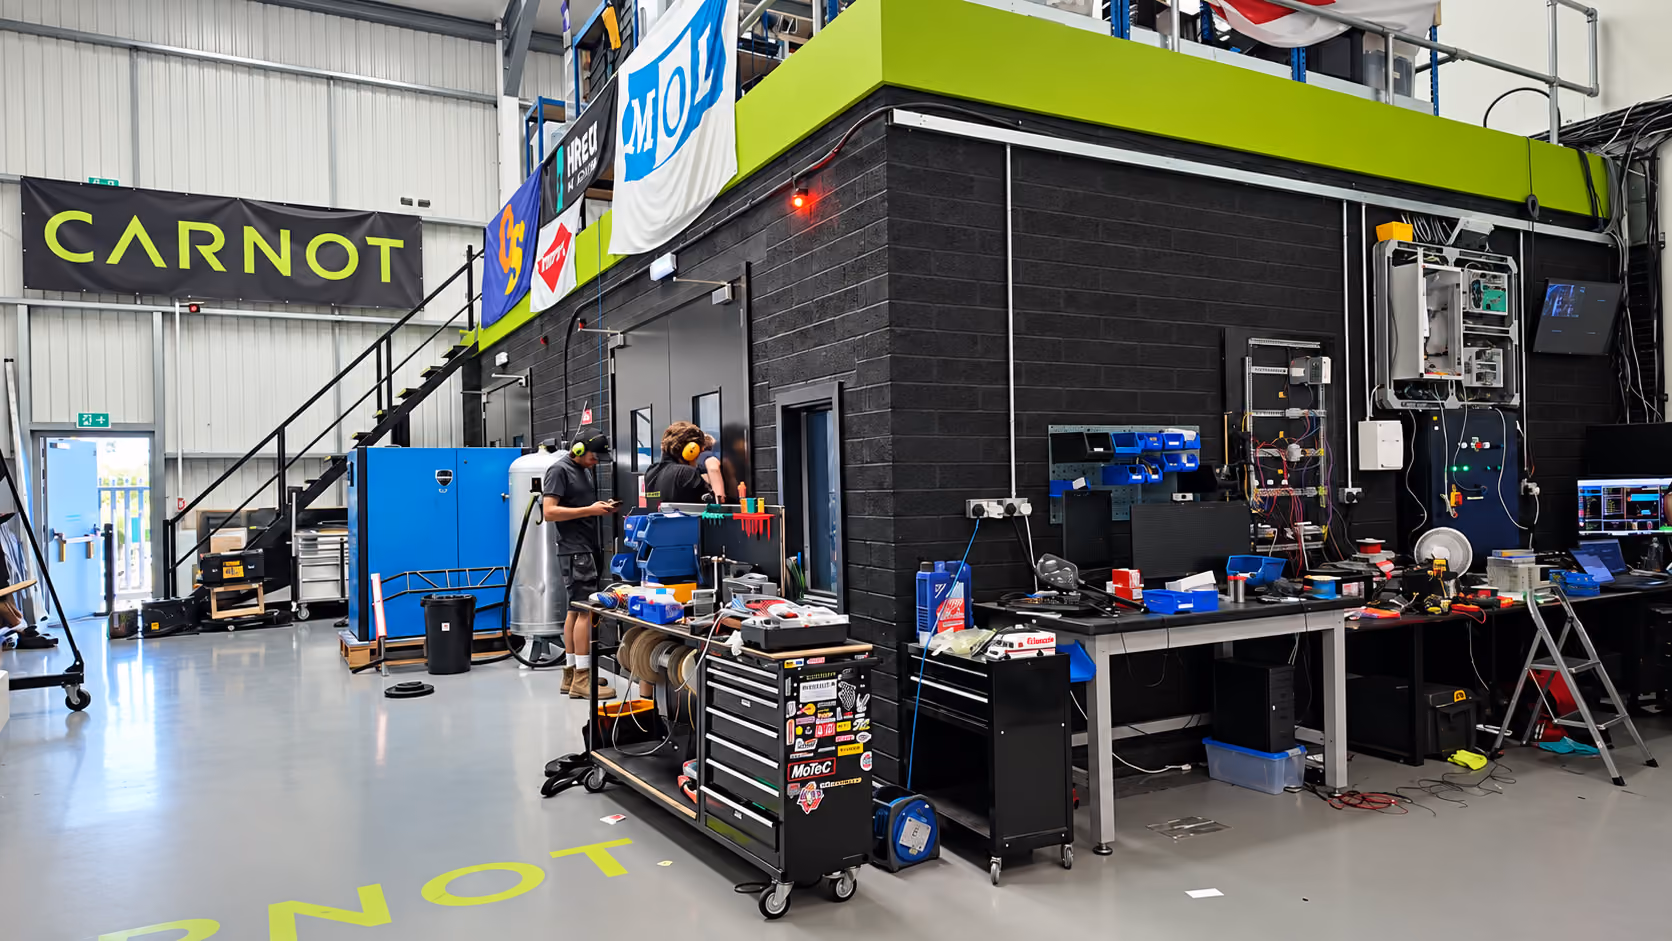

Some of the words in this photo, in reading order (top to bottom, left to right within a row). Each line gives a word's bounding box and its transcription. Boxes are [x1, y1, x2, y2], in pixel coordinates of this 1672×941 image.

[624, 22, 714, 155] MOL
[44, 210, 404, 282] CARNOT
[791, 761, 832, 779] MoTeC
[97, 837, 633, 941] NOT
